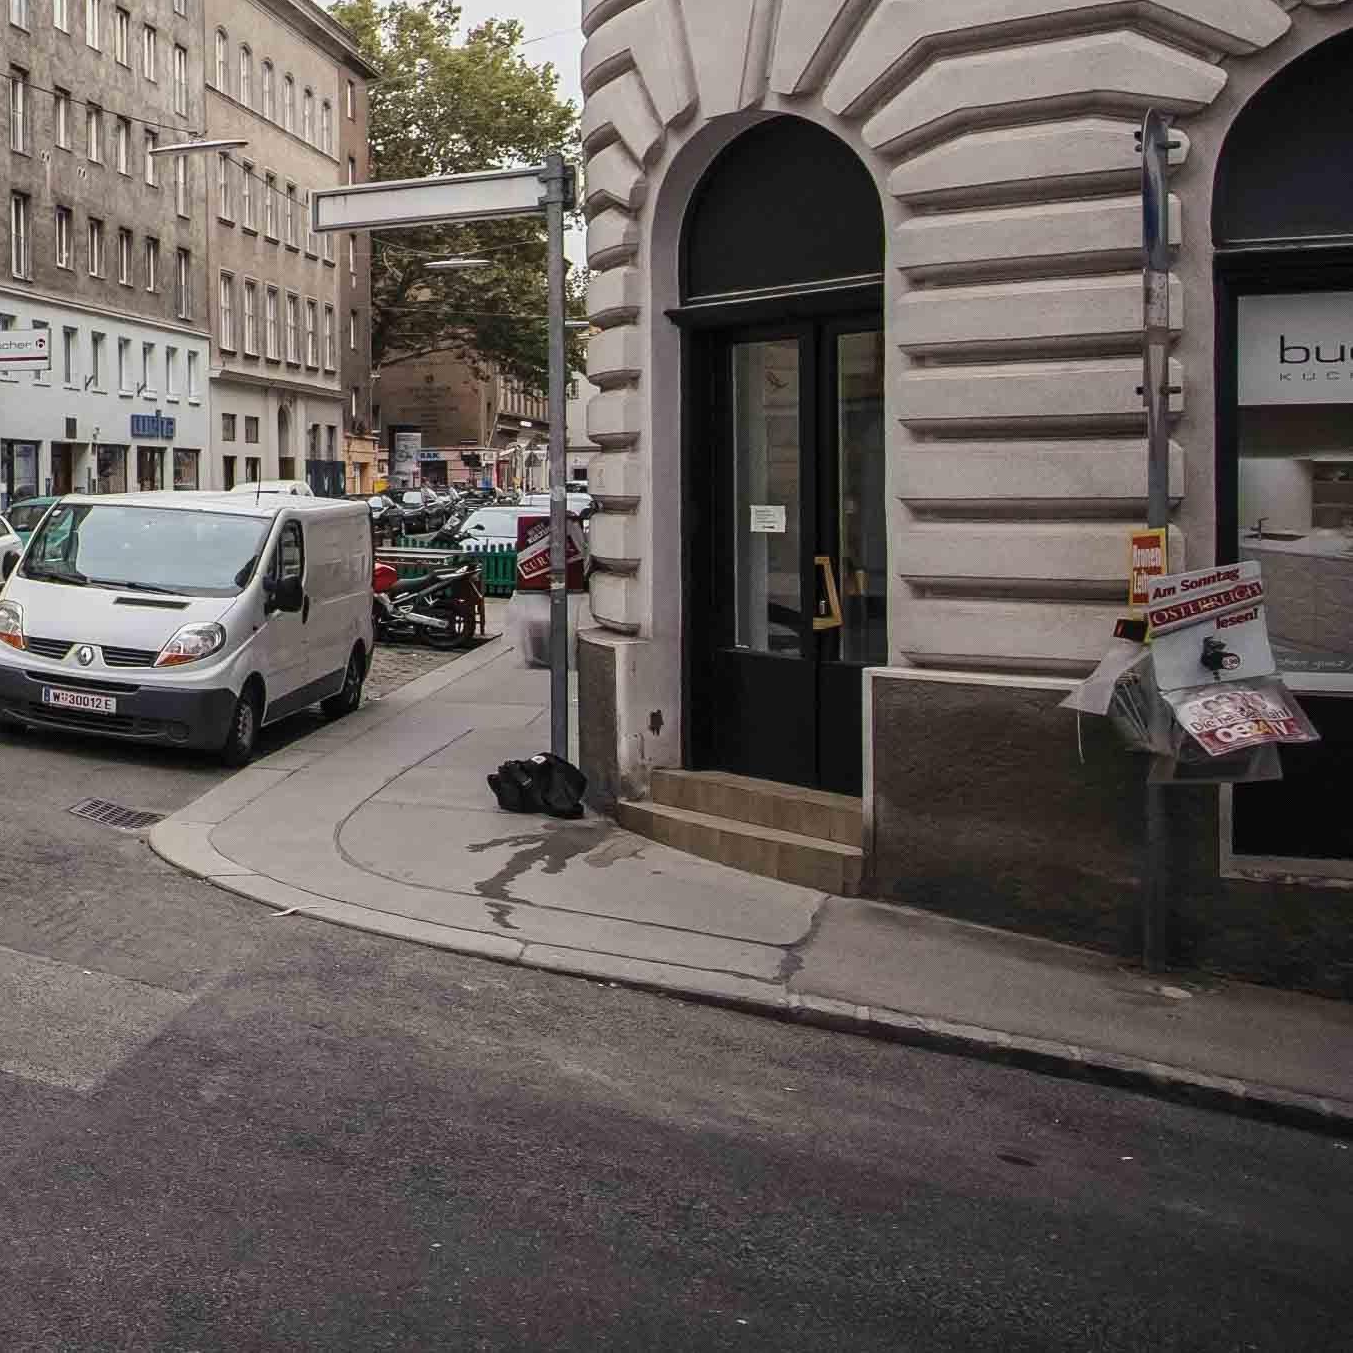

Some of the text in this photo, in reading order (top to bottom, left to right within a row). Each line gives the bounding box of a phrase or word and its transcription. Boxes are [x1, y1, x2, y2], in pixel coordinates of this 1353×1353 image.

[1279, 334, 1353, 364] bu
[1153, 567, 1240, 599] Am Sonntag
[1215, 608, 1258, 629] lesen!
